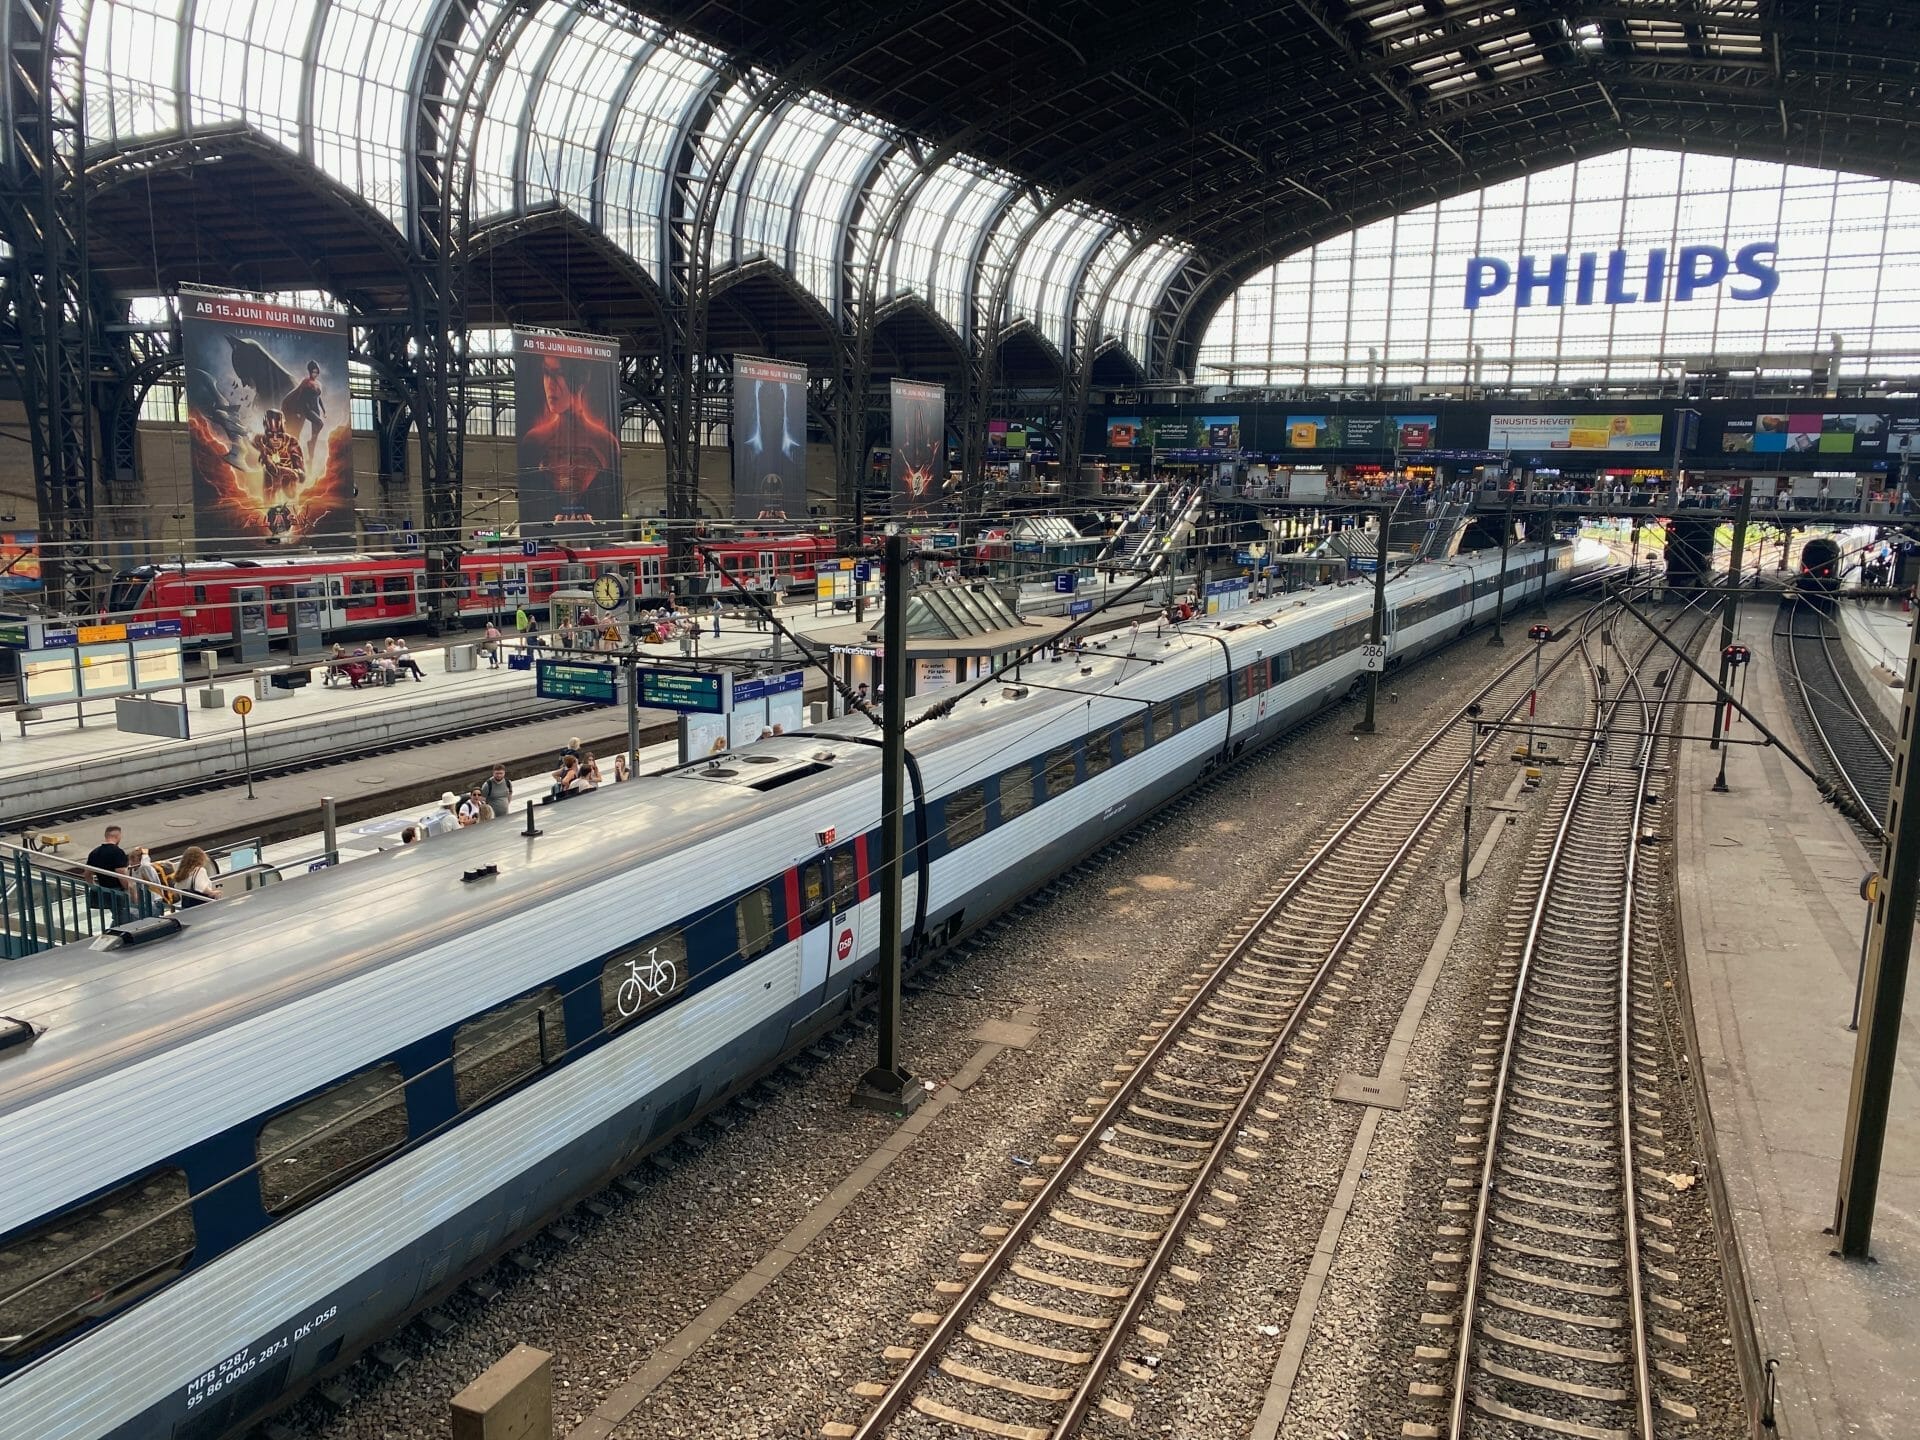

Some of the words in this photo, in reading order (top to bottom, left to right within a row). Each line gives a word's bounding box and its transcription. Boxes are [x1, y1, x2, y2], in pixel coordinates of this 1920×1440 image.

[1463, 242, 1781, 309] PHILIPS
[196, 302, 213, 313] AB
[216, 305, 234, 316] 15.
[235, 308, 262, 319] JUNI
[266, 311, 289, 323] NUR
[292, 315, 306, 324] IM
[309, 316, 335, 328] KINO
[524, 340, 534, 348] AB
[548, 343, 565, 352] JUNI
[566, 346, 582, 354] NUR
[594, 348, 611, 357] KINO
[1494, 418, 1538, 426] SINUSITIS
[526, 541, 536, 554] D
[856, 564, 864, 578] E
[1058, 576, 1066, 590] E
[830, 644, 876, 656] ServiceStore
[1362, 646, 1383, 657] 286
[546, 666, 550, 674] 7
[1368, 658, 1375, 668] 6
[712, 680, 718, 690] 8
[838, 938, 852, 952] DSB
[187, 1393, 204, 1410] 95
[206, 1380, 222, 1396] 86
[225, 1358, 256, 1384] 0005
[258, 1336, 288, 1364] 287-1
[294, 1304, 338, 1342] DK-DSB
[188, 1369, 216, 1396] MFB
[219, 1348, 249, 1376] 5287
